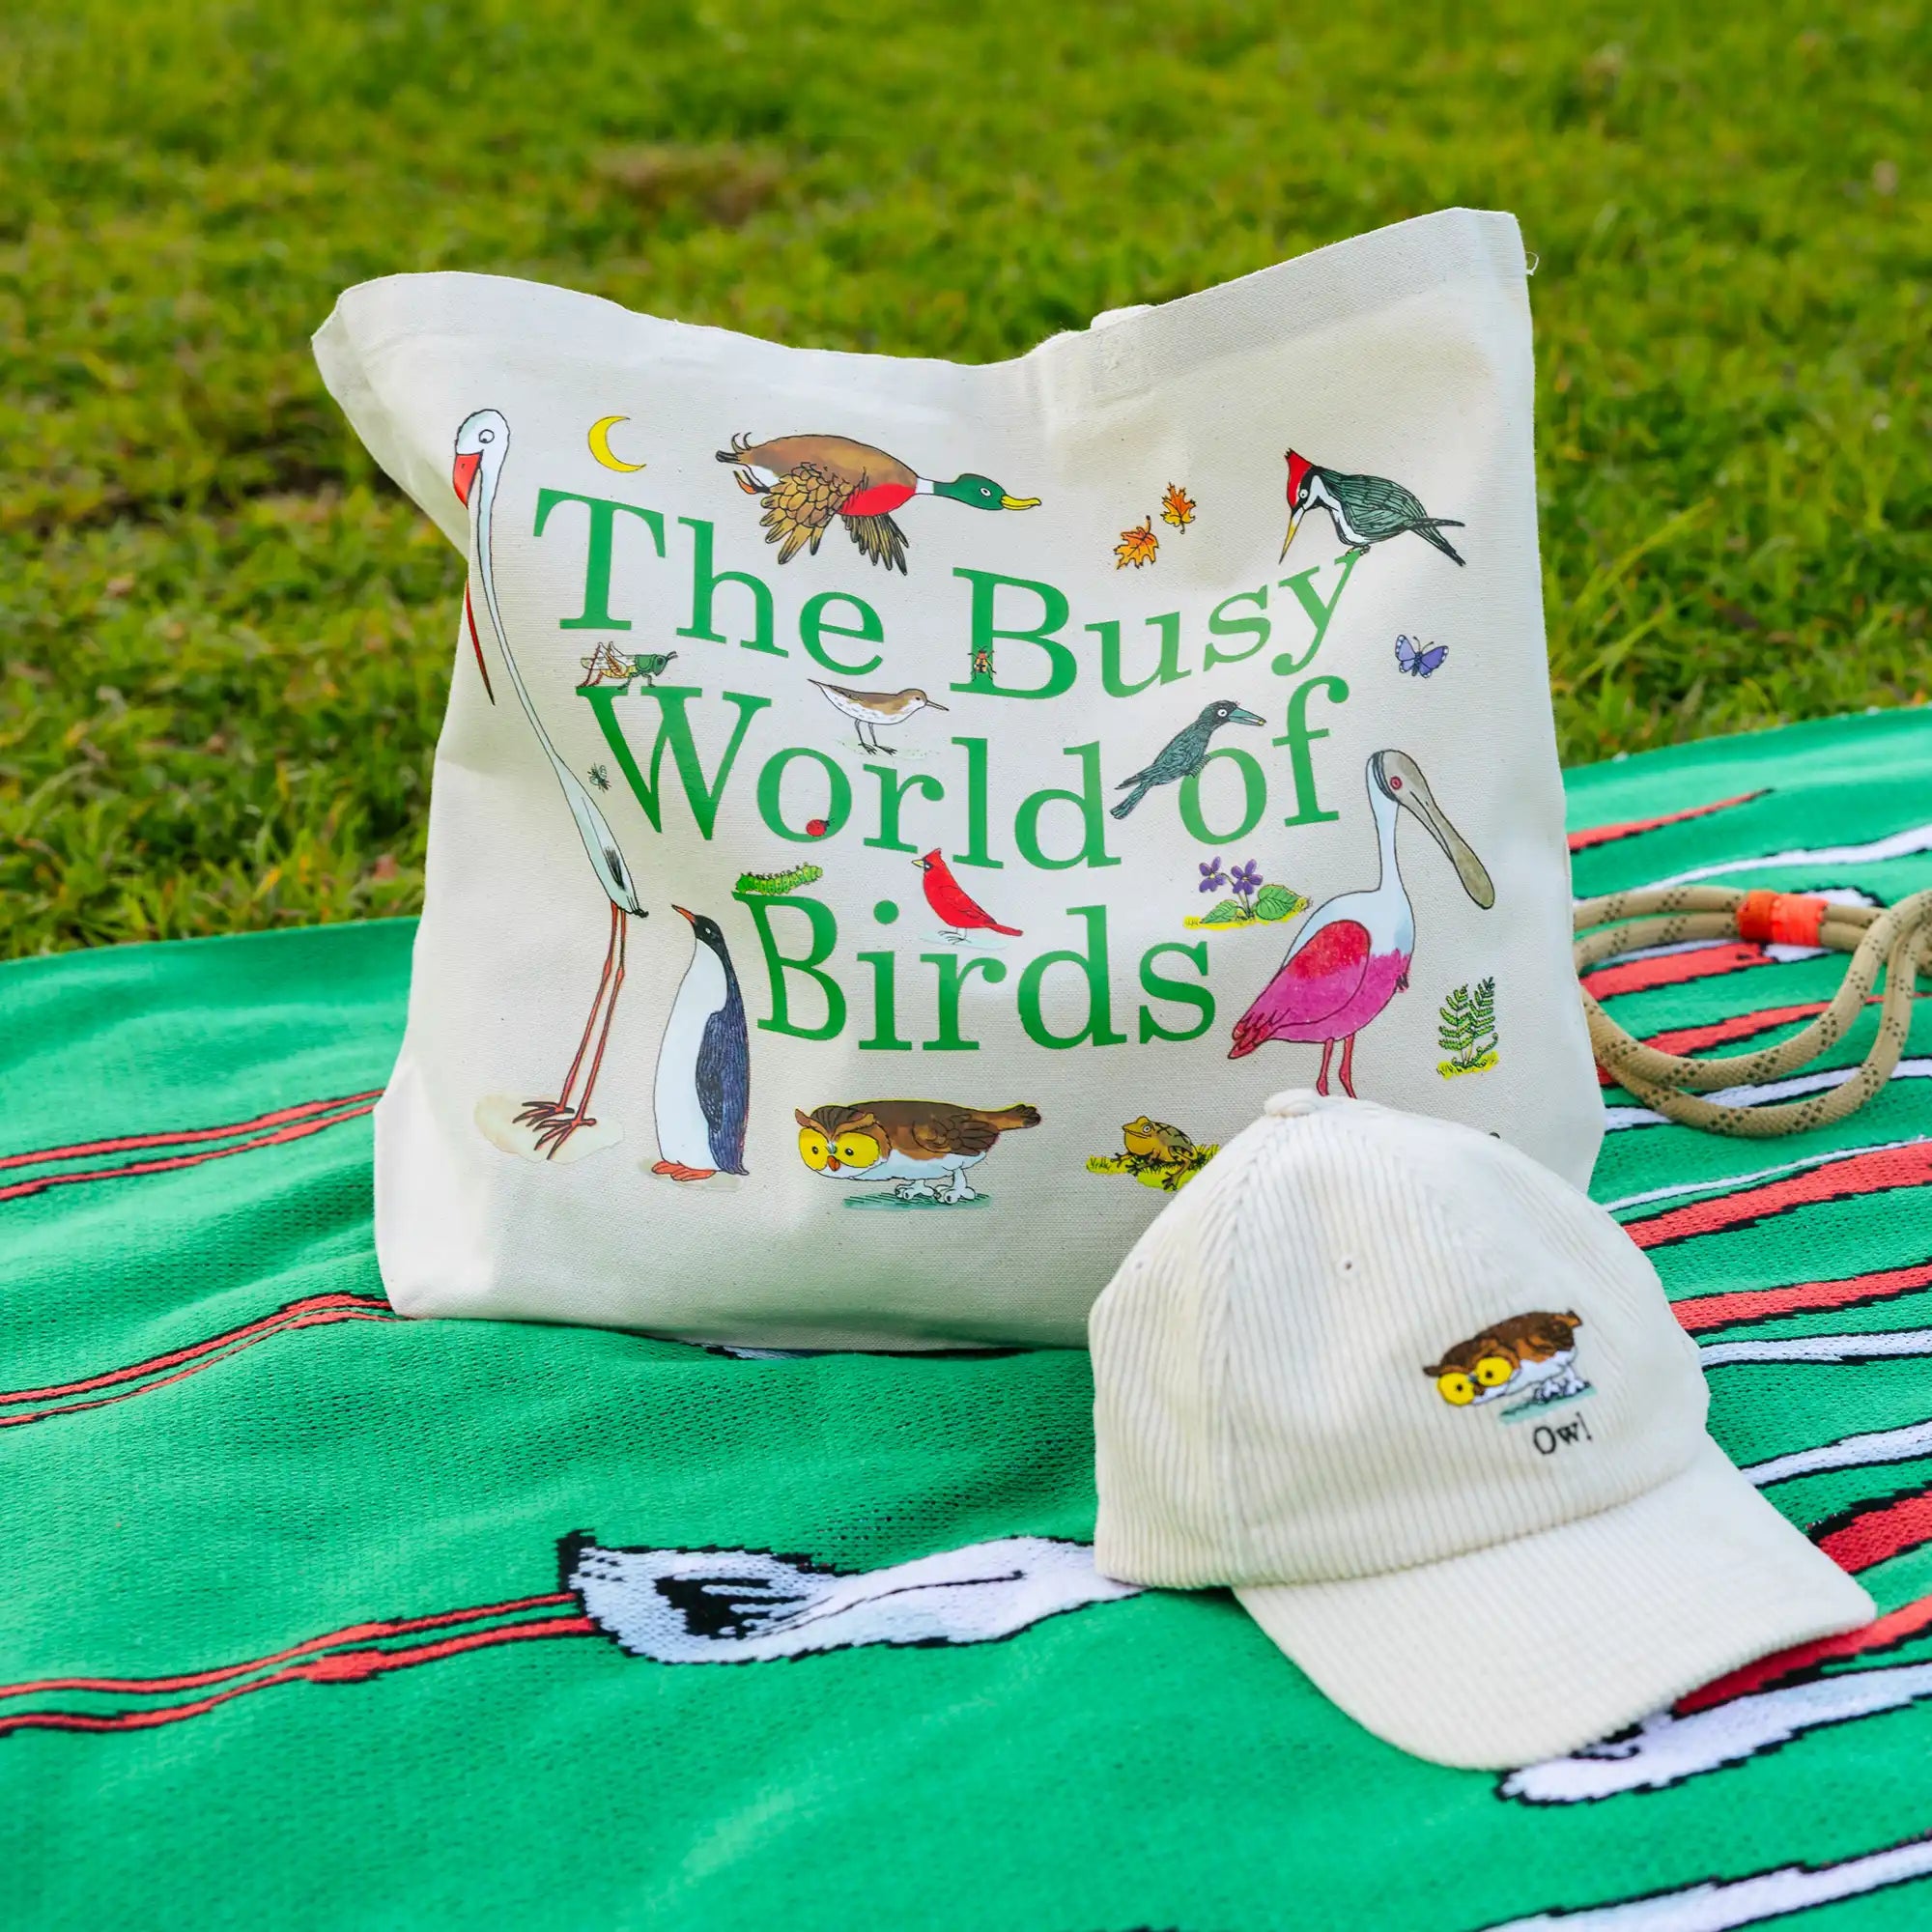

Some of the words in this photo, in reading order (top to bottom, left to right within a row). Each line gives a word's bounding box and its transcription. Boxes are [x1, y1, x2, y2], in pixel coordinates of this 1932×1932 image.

[533, 488, 884, 676] The
[950, 550, 1362, 699] Busy
[576, 684, 1122, 870] World
[1178, 675, 1350, 845] of
[731, 890, 1217, 1051] Birds
